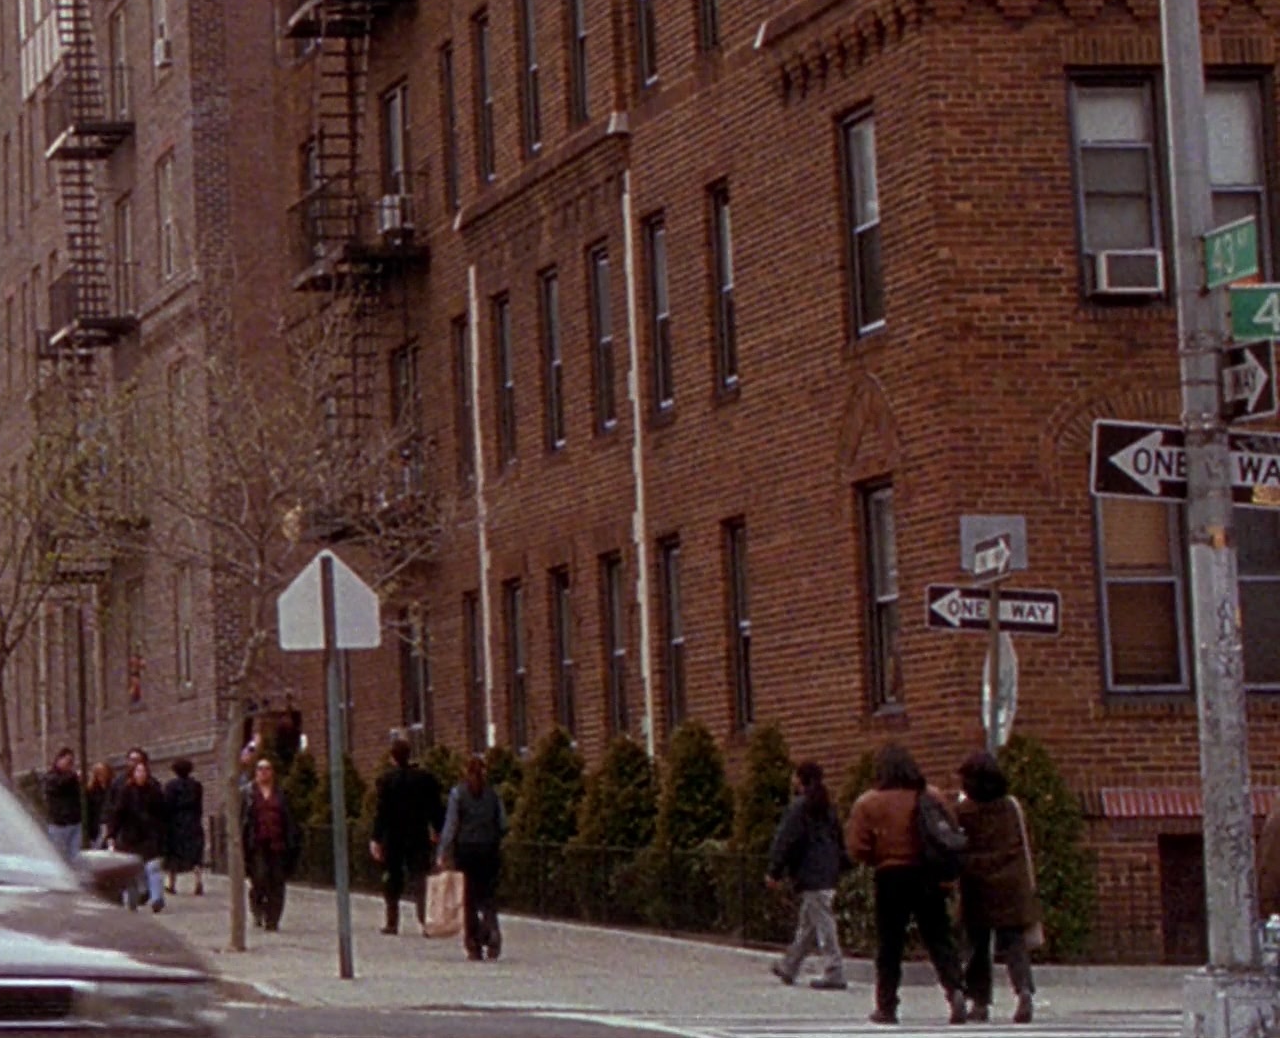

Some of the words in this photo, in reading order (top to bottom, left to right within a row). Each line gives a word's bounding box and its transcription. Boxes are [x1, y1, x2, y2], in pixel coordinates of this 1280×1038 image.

[1133, 447, 1186, 477] ONE
[948, 597, 985, 619] ONE
[1011, 602, 1050, 622] WAY
